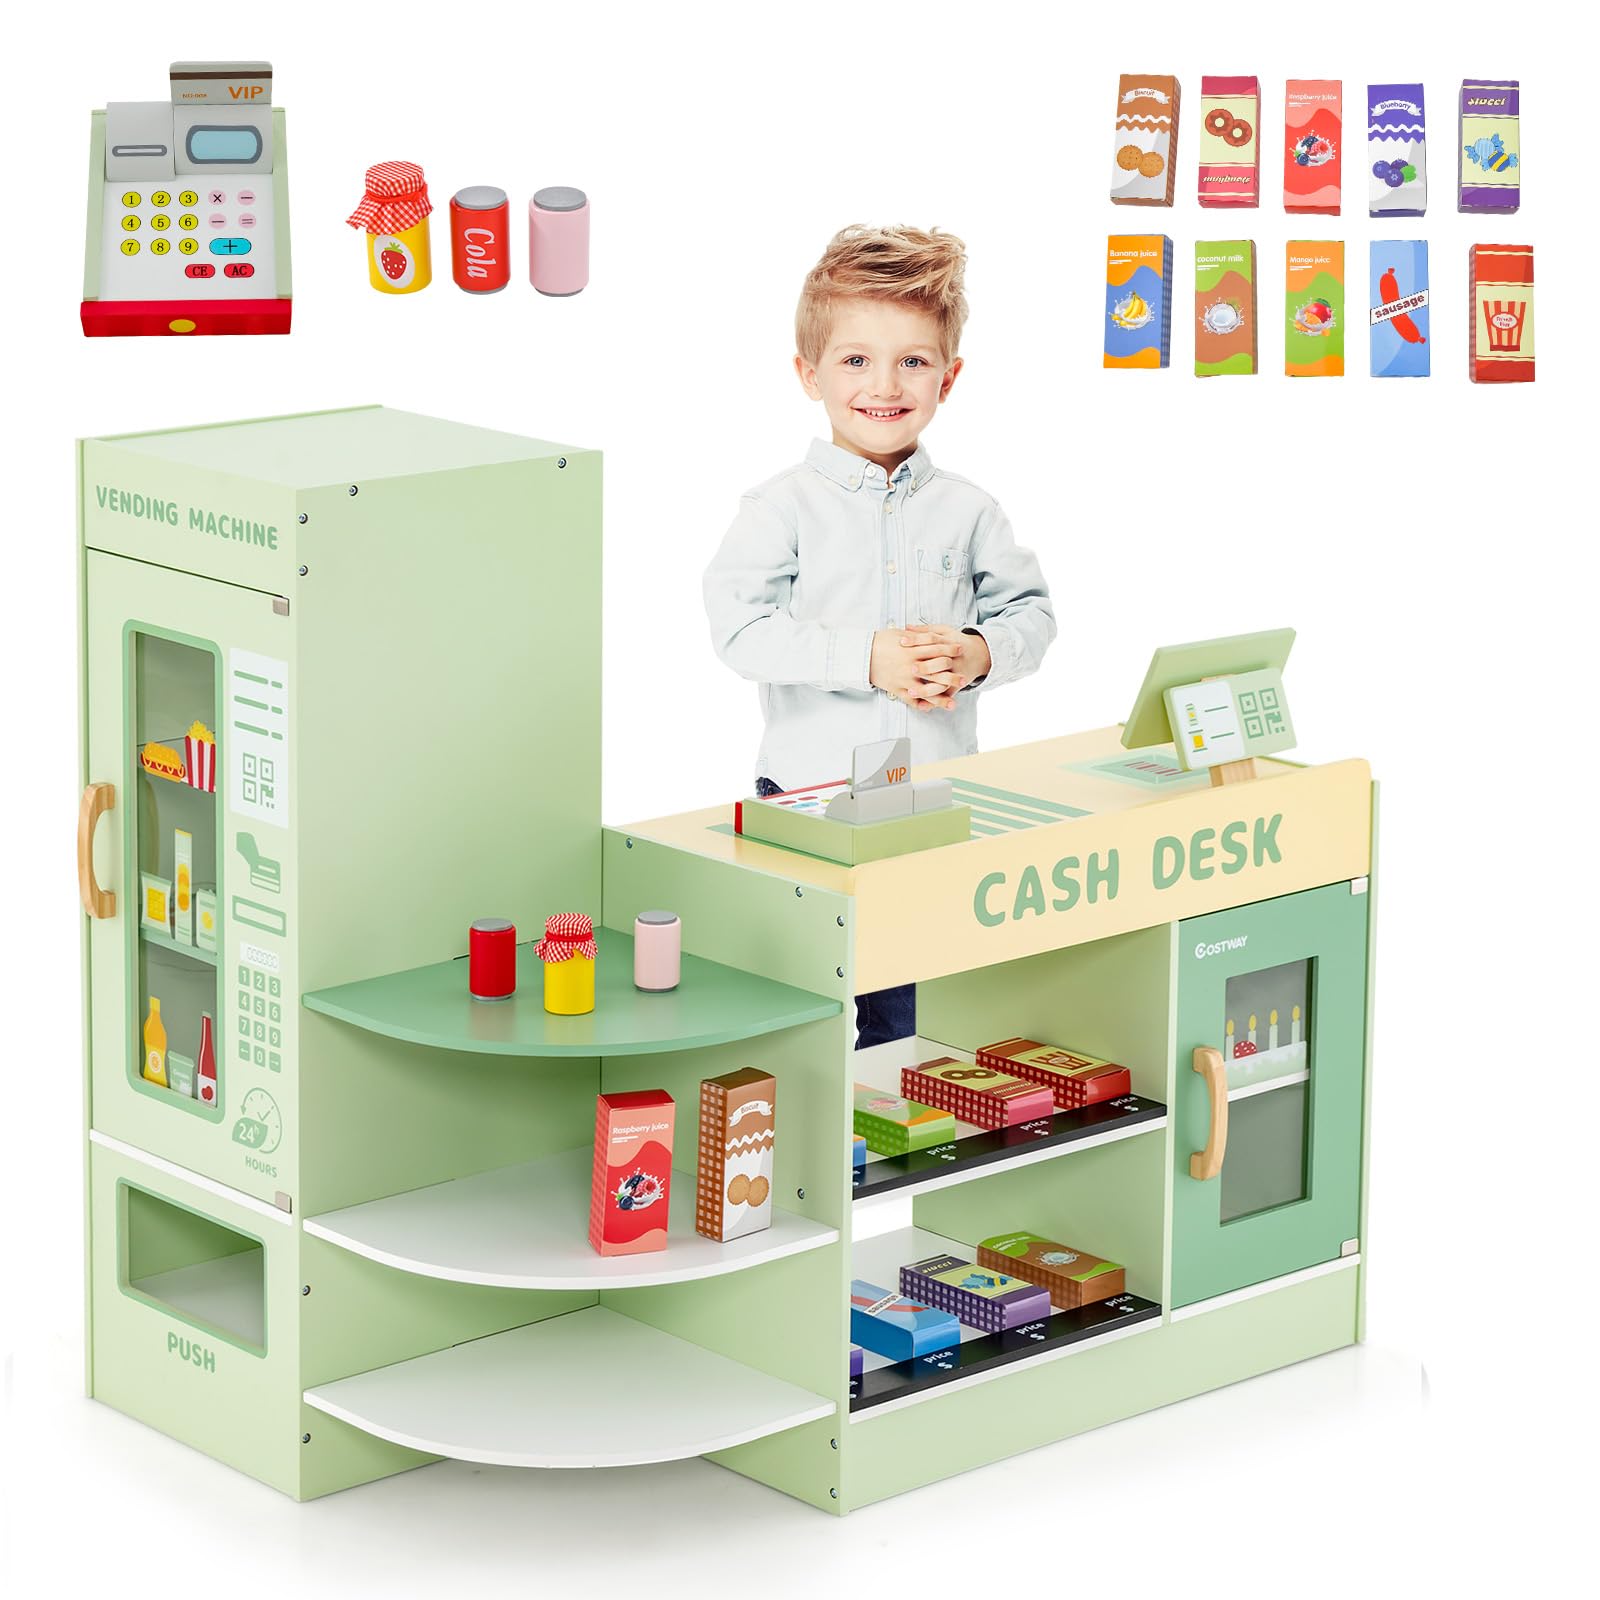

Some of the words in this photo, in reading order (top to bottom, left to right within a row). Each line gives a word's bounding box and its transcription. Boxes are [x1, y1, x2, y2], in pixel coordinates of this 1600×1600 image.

[228, 86, 263, 100] VIP
[128, 194, 134, 205] 1
[157, 194, 165, 204] 2
[185, 194, 192, 204] 3
[127, 218, 134, 228] 4
[157, 218, 165, 228] 5
[184, 217, 192, 227] 6
[127, 242, 134, 252] 7
[156, 242, 164, 252] 8
[184, 242, 192, 252] 9
[464, 227, 497, 278] Cola
[1227, 254, 1244, 262] milk
[1290, 256, 1313, 264] Mango
[192, 265, 208, 277] CE
[231, 265, 248, 277] AC
[1374, 294, 1425, 319] sausage
[96, 485, 178, 526] VENDING
[189, 507, 278, 550] MACHINE
[886, 766, 907, 784] VIP
[974, 848, 1119, 928] CASH
[1152, 813, 1283, 890] DESK
[1195, 935, 1248, 959] COSTWAY
[256, 975, 262, 989] 2
[271, 980, 278, 994] 3
[241, 995, 247, 1009] 4
[256, 1000, 262, 1014] 5
[271, 1006, 278, 1019] 6
[241, 1019, 247, 1032] 7
[256, 1025, 262, 1038] 8
[271, 1031, 278, 1044] 9
[1110, 1096, 1138, 1107] price
[612, 1124, 651, 1135] Raspberry
[651, 1122, 670, 1132] juice
[1019, 1120, 1049, 1131] price
[927, 1144, 957, 1156] price
[245, 1156, 277, 1178] HOURS
[1104, 1295, 1134, 1307] price
[1016, 1322, 1045, 1335] price
[168, 1331, 215, 1373] PUSH
[923, 1351, 954, 1364] price
